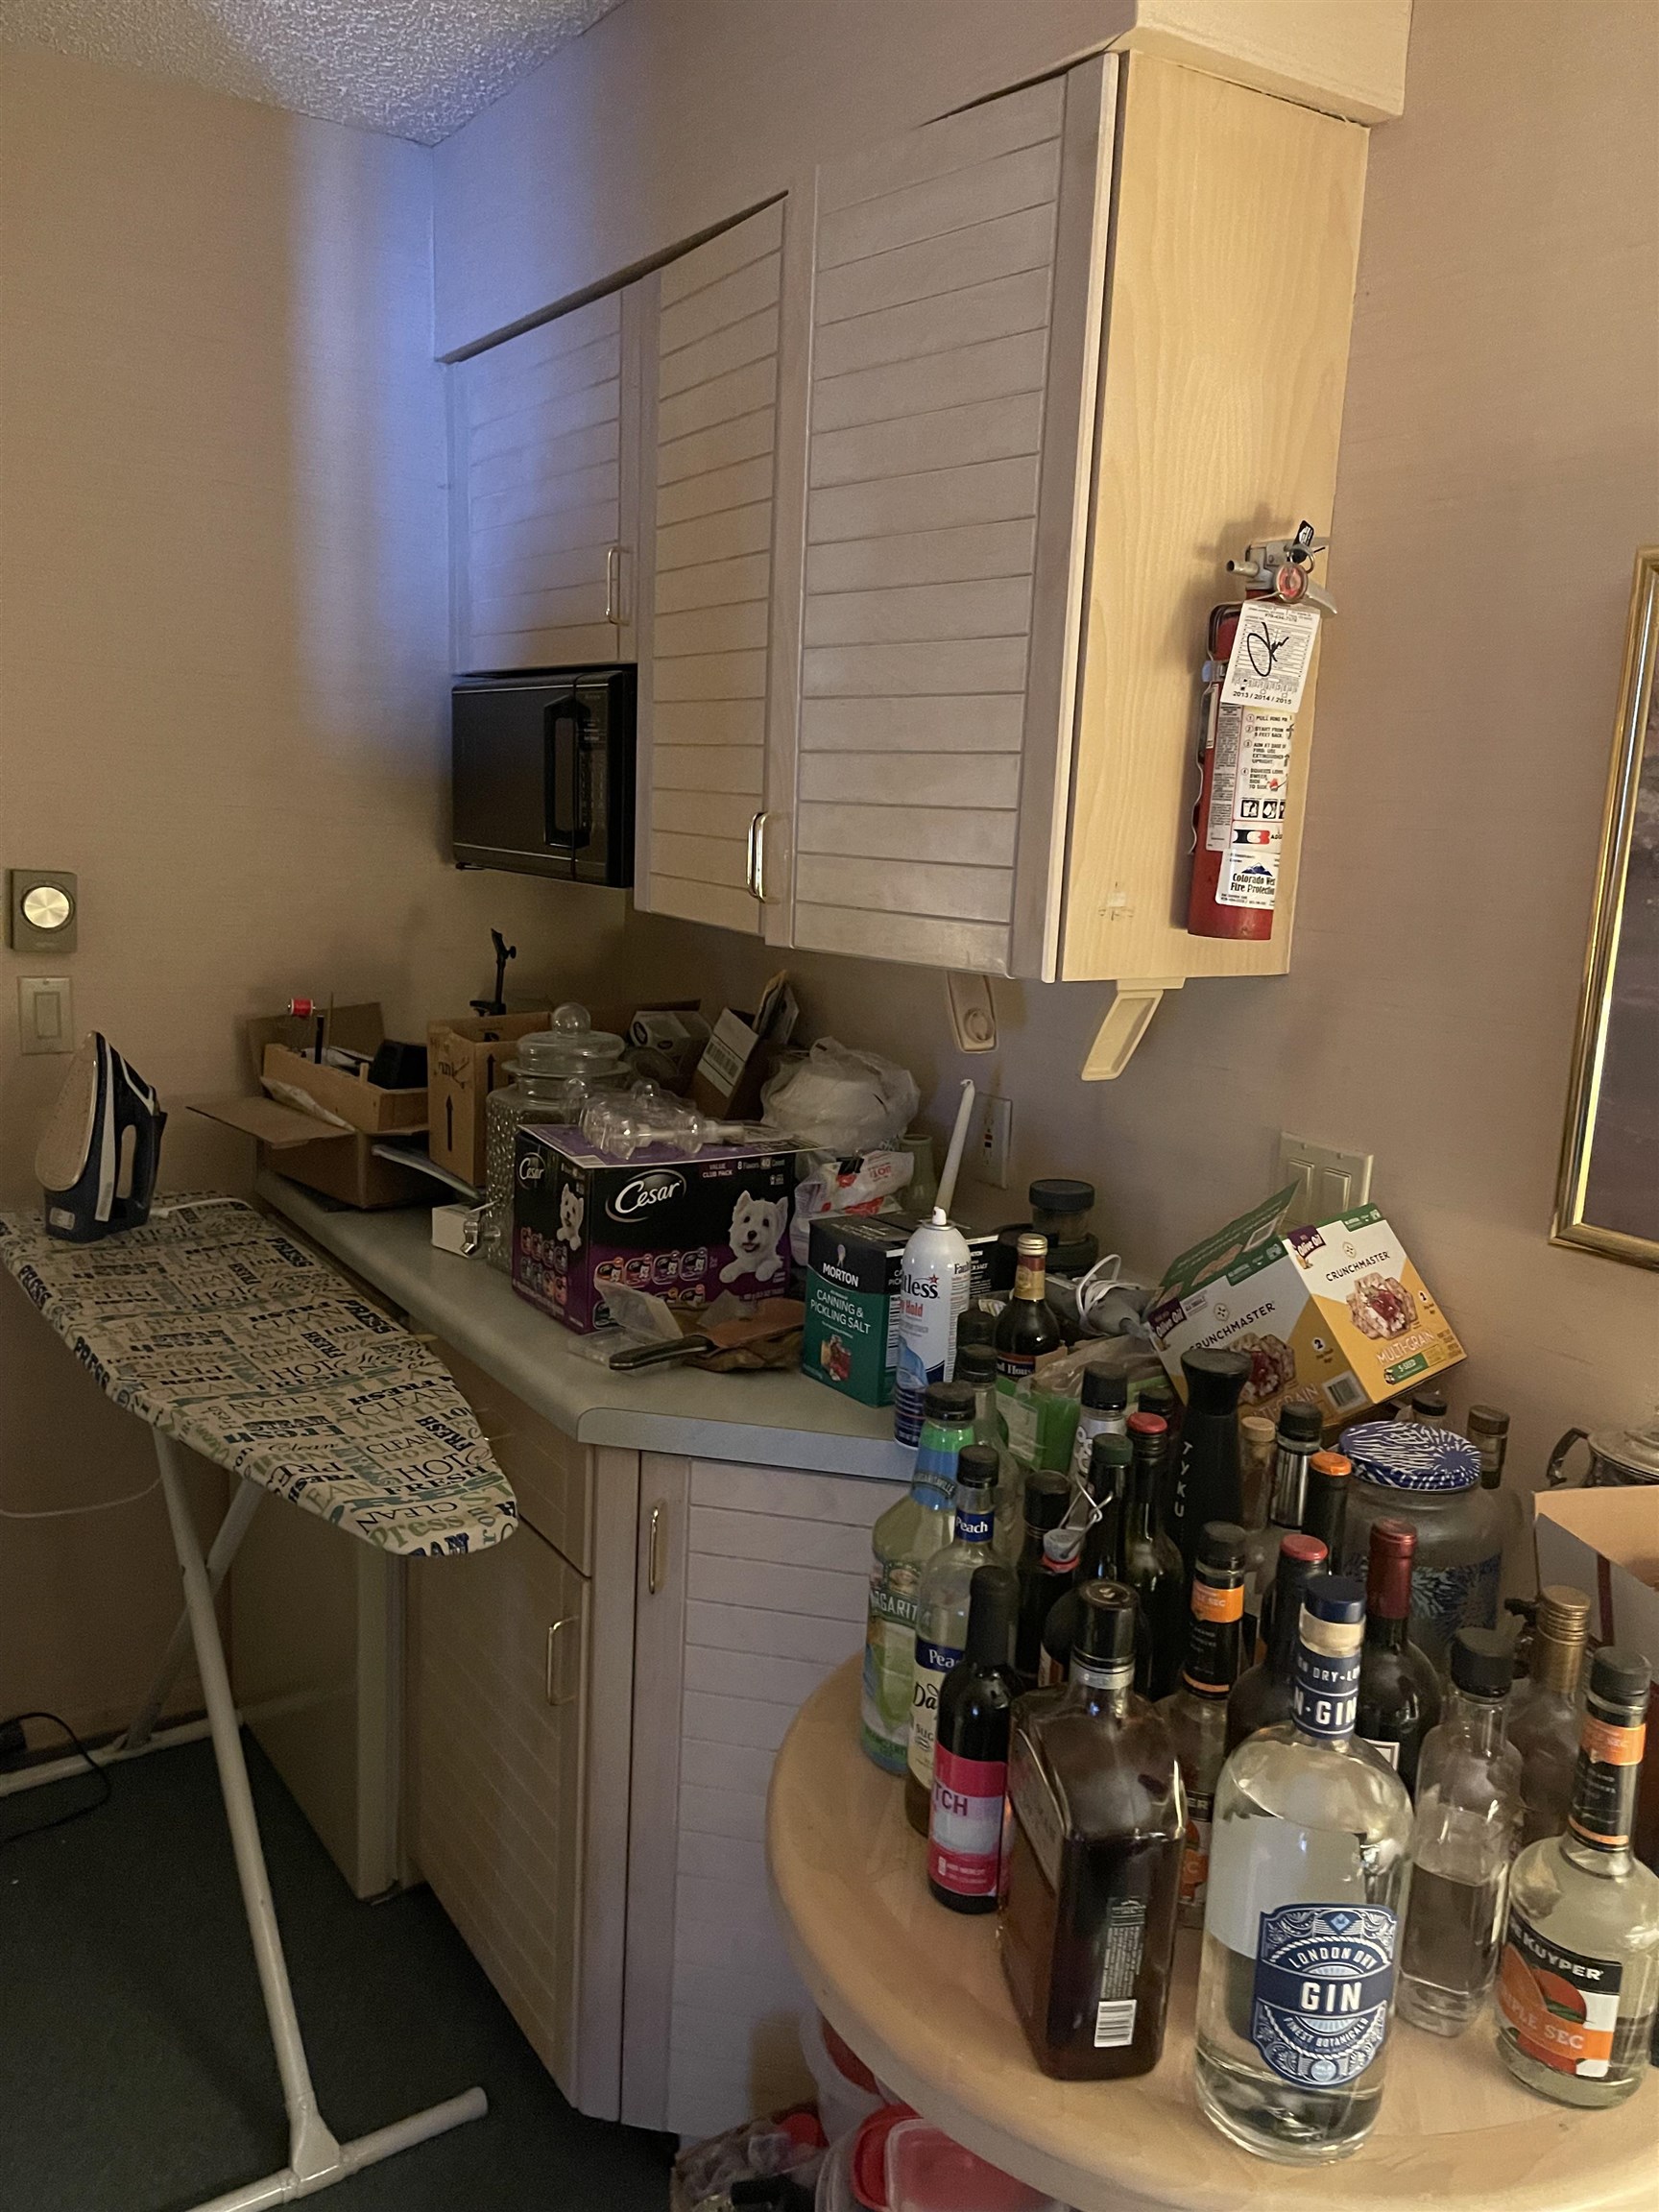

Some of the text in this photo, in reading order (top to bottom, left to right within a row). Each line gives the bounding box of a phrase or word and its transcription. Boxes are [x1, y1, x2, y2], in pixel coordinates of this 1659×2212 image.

[1230, 881, 1245, 892] Fire
[1232, 873, 1264, 884] Colorado
[519, 1157, 545, 1180] Cesar
[702, 1170, 717, 1179] CLUB
[737, 1161, 743, 1170] 8
[614, 1179, 682, 1214] Cesar
[823, 1262, 859, 1288] MORTON
[1325, 1250, 1391, 1283] CRUNCHMASTER
[332, 1297, 402, 1333] PRESS
[810, 1298, 847, 1326] PICKLING
[847, 1317, 872, 1335] SALT
[816, 1288, 855, 1315] CANNING
[856, 1307, 864, 1319] &
[905, 1300, 924, 1318] Hold
[247, 1307, 348, 1331] CLEAN
[245, 1342, 315, 1359] CLEAN
[299, 1331, 349, 1358] FRESH
[1376, 1330, 1435, 1365] MULTI-GRAIN
[73, 1334, 112, 1392] PRESS
[267, 1358, 341, 1381] HOT
[227, 1393, 321, 1410] CLEAN
[344, 1380, 439, 1406] FRESH
[348, 1384, 459, 1417] CLEAN
[360, 1431, 440, 1456] CLEAN
[413, 1415, 475, 1452] FRESH
[380, 1464, 494, 1496] FRESH
[391, 1452, 475, 1482] HOT
[1174, 1441, 1194, 1518] TYKU
[355, 1502, 459, 1535] CLEAN
[955, 1515, 989, 1534] Peach
[1208, 1597, 1226, 1608] SEC
[1315, 1696, 1358, 1726] GIN
[1288, 1946, 1378, 1970] LONDON DRY
[1523, 1932, 1601, 1982] KUYPER
[1300, 1981, 1363, 2012] GIN
[1283, 2016, 1370, 2048] FINEST BOTANICALS
[1544, 2024, 1585, 2050] SEC
